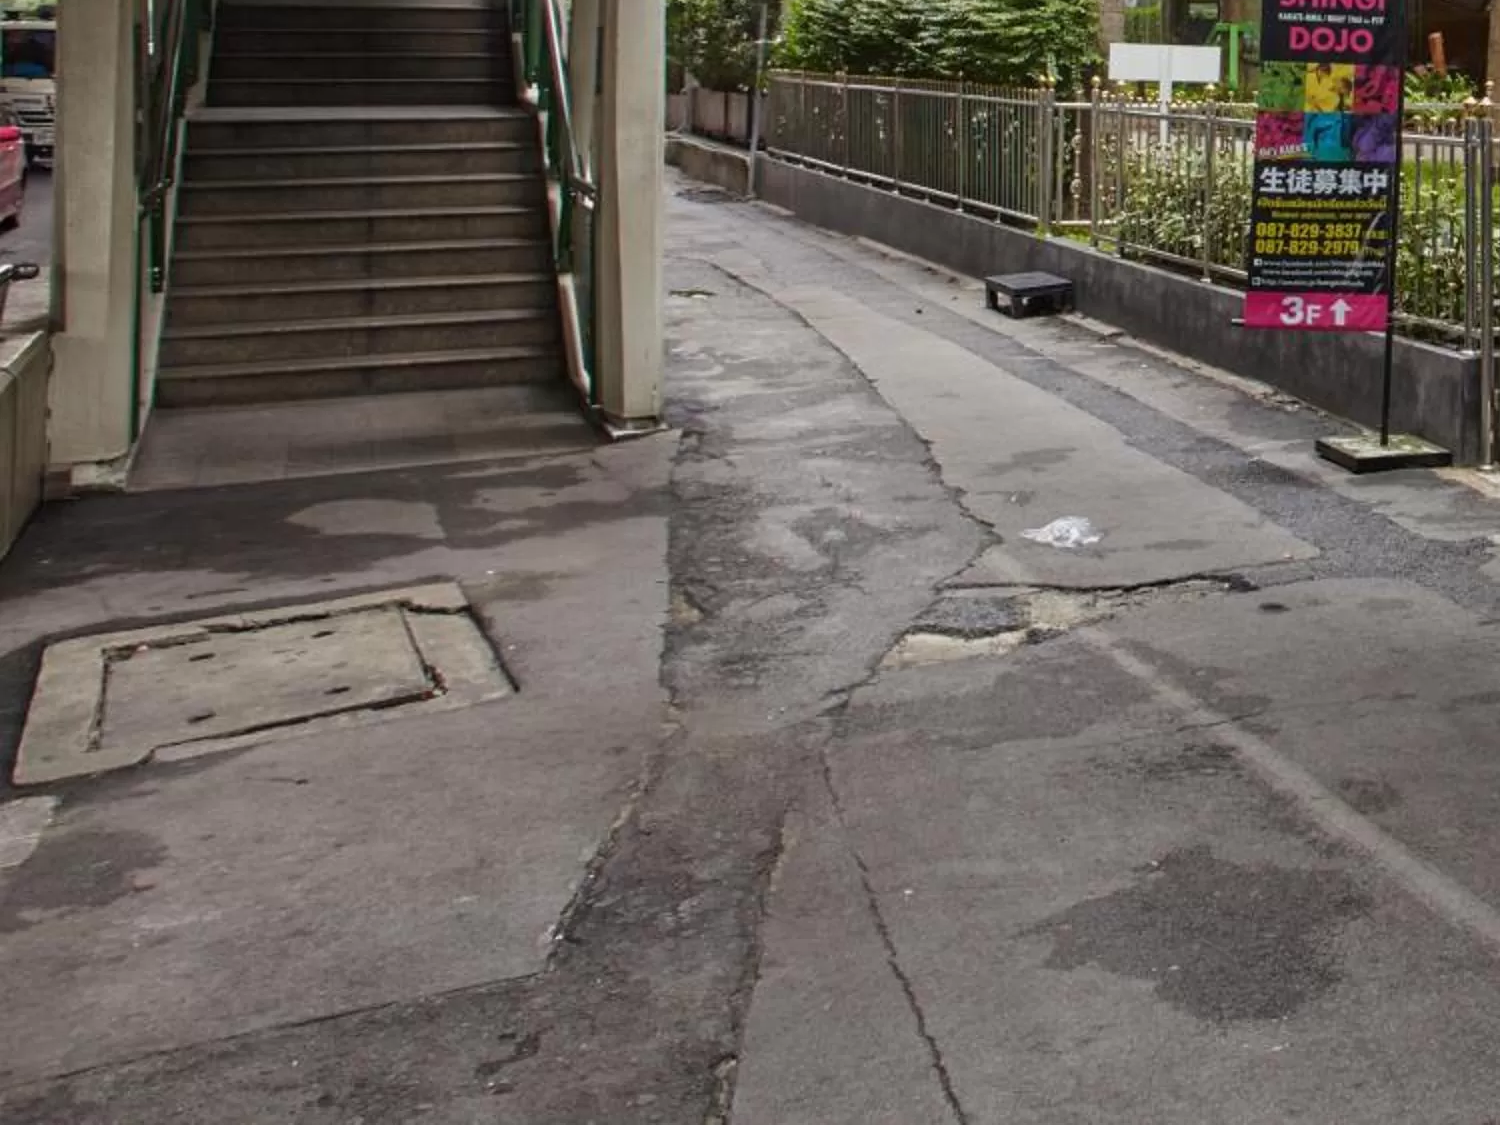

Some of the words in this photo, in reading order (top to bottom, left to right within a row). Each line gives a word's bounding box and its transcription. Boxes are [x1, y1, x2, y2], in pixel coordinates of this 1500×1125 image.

[1288, 26, 1375, 53] DOJO
[1258, 166, 1388, 195] 生徒募集中
[1279, 295, 1323, 326] 3F
